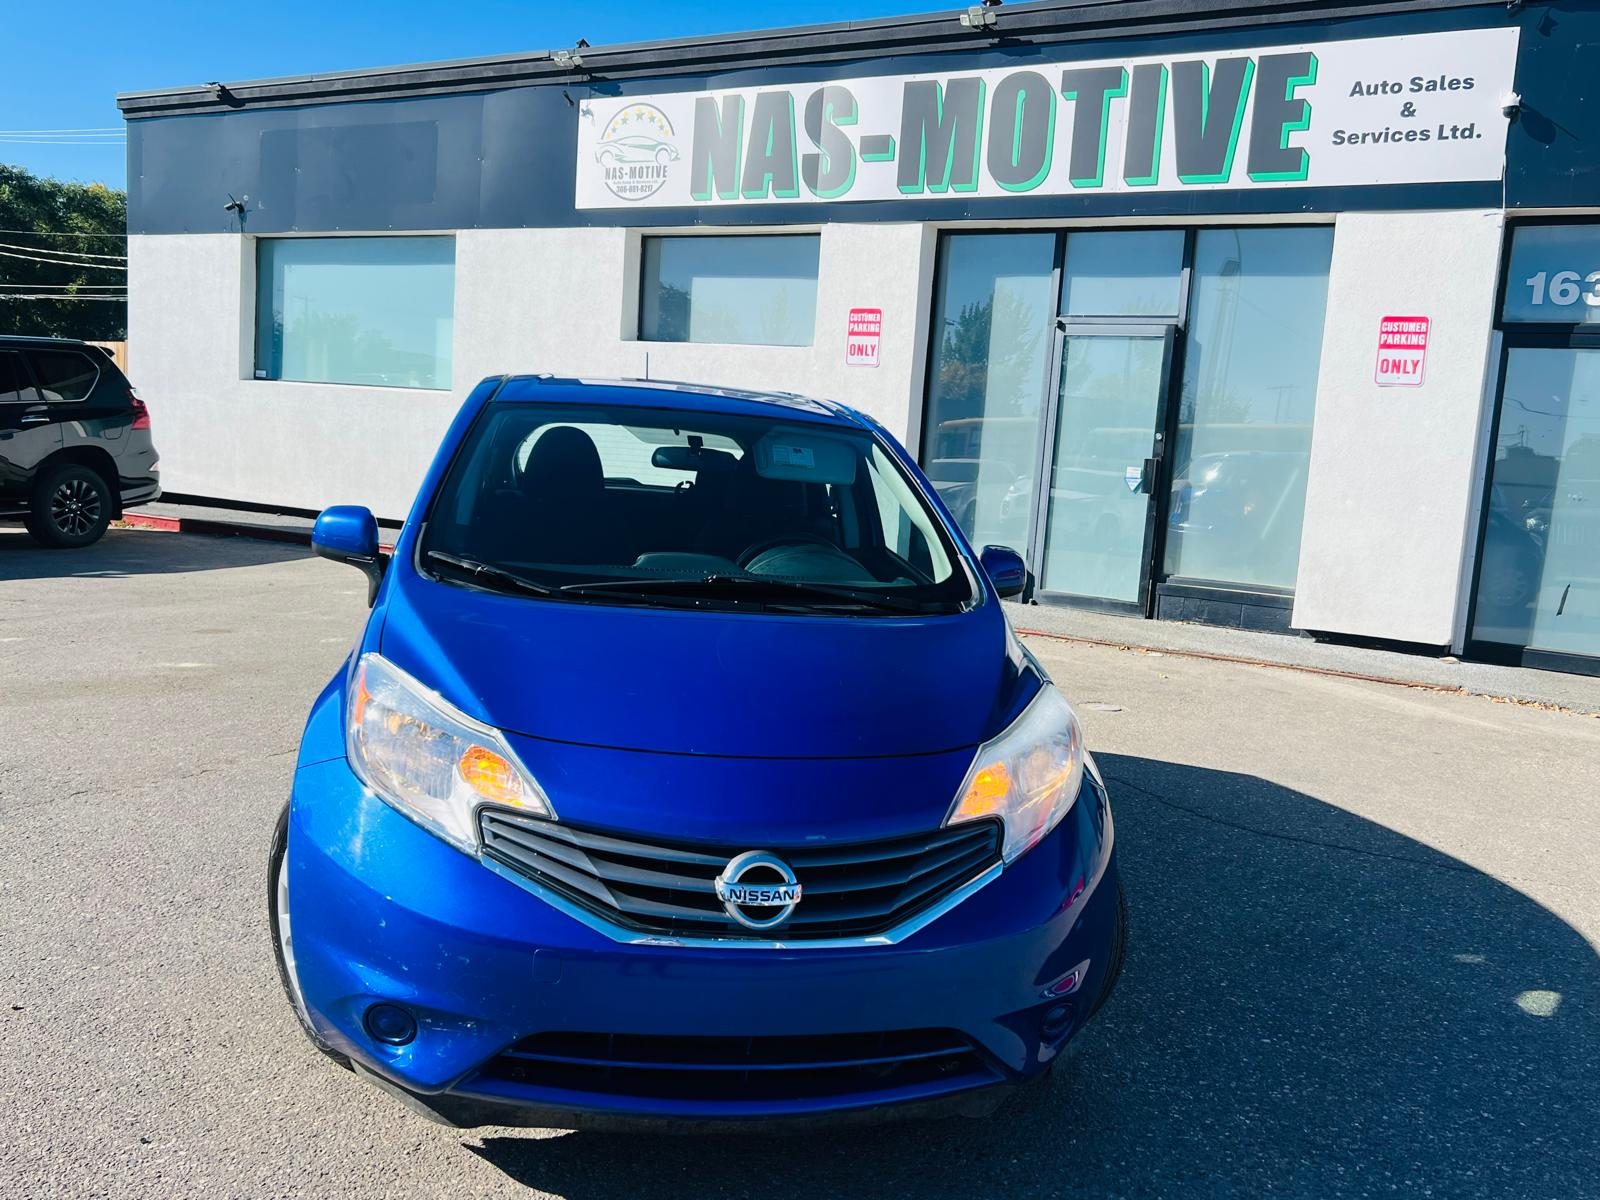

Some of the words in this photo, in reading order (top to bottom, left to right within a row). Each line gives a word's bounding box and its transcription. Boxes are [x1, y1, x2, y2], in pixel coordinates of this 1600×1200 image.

[1349, 80, 1403, 98] Auto
[1409, 75, 1475, 93] Sales
[1400, 101, 1417, 118] &
[690, 52, 1319, 201] NAS-MOTIVE
[1332, 127, 1431, 146] Services
[1437, 123, 1482, 140] Ltd.
[604, 165, 668, 181] NAS-MOTIVE
[849, 323, 880, 333] PARKING
[1381, 321, 1427, 333] CUSTOMER
[1380, 333, 1426, 345] PARKING
[849, 343, 877, 357] ONLY
[1380, 358, 1420, 375] ONLY
[729, 888, 795, 902] NISSAN
